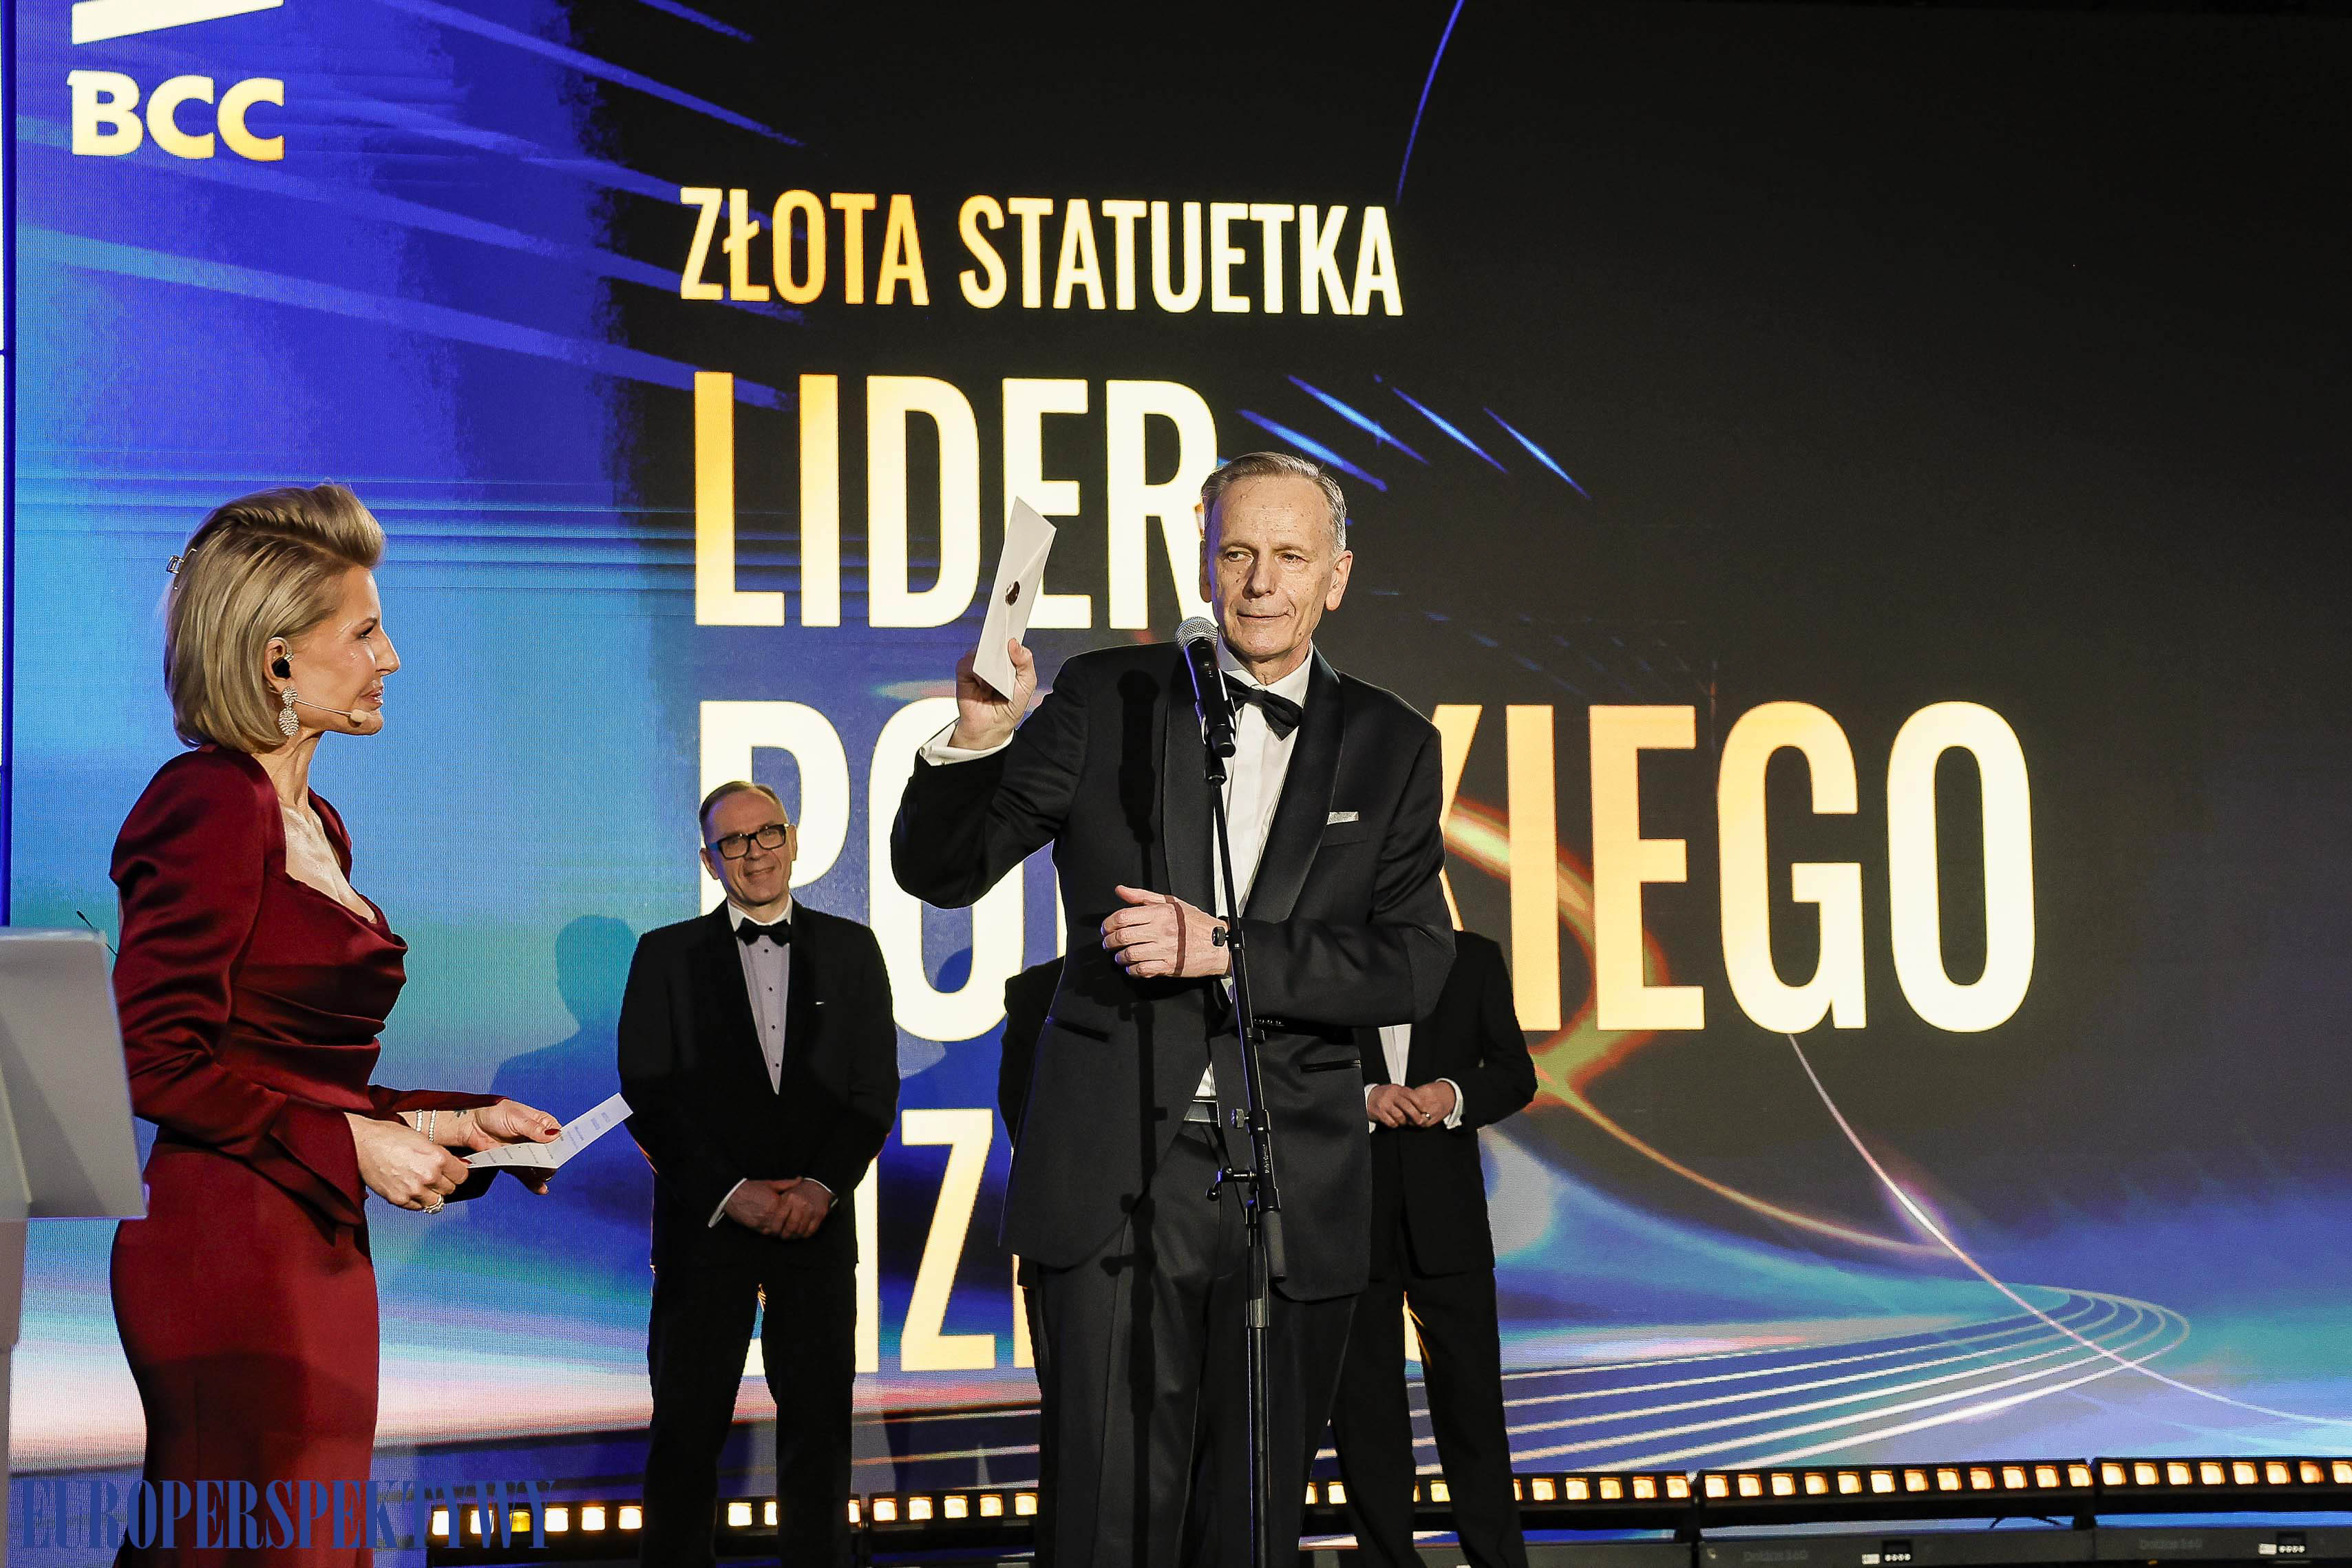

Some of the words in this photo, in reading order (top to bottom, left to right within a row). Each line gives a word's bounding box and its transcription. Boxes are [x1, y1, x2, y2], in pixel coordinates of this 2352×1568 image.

[67, 70, 285, 162] BCC
[680, 187, 930, 306] ZŁOTA
[959, 195, 1403, 317] STATUETKA
[694, 371, 1219, 630] LIDER
